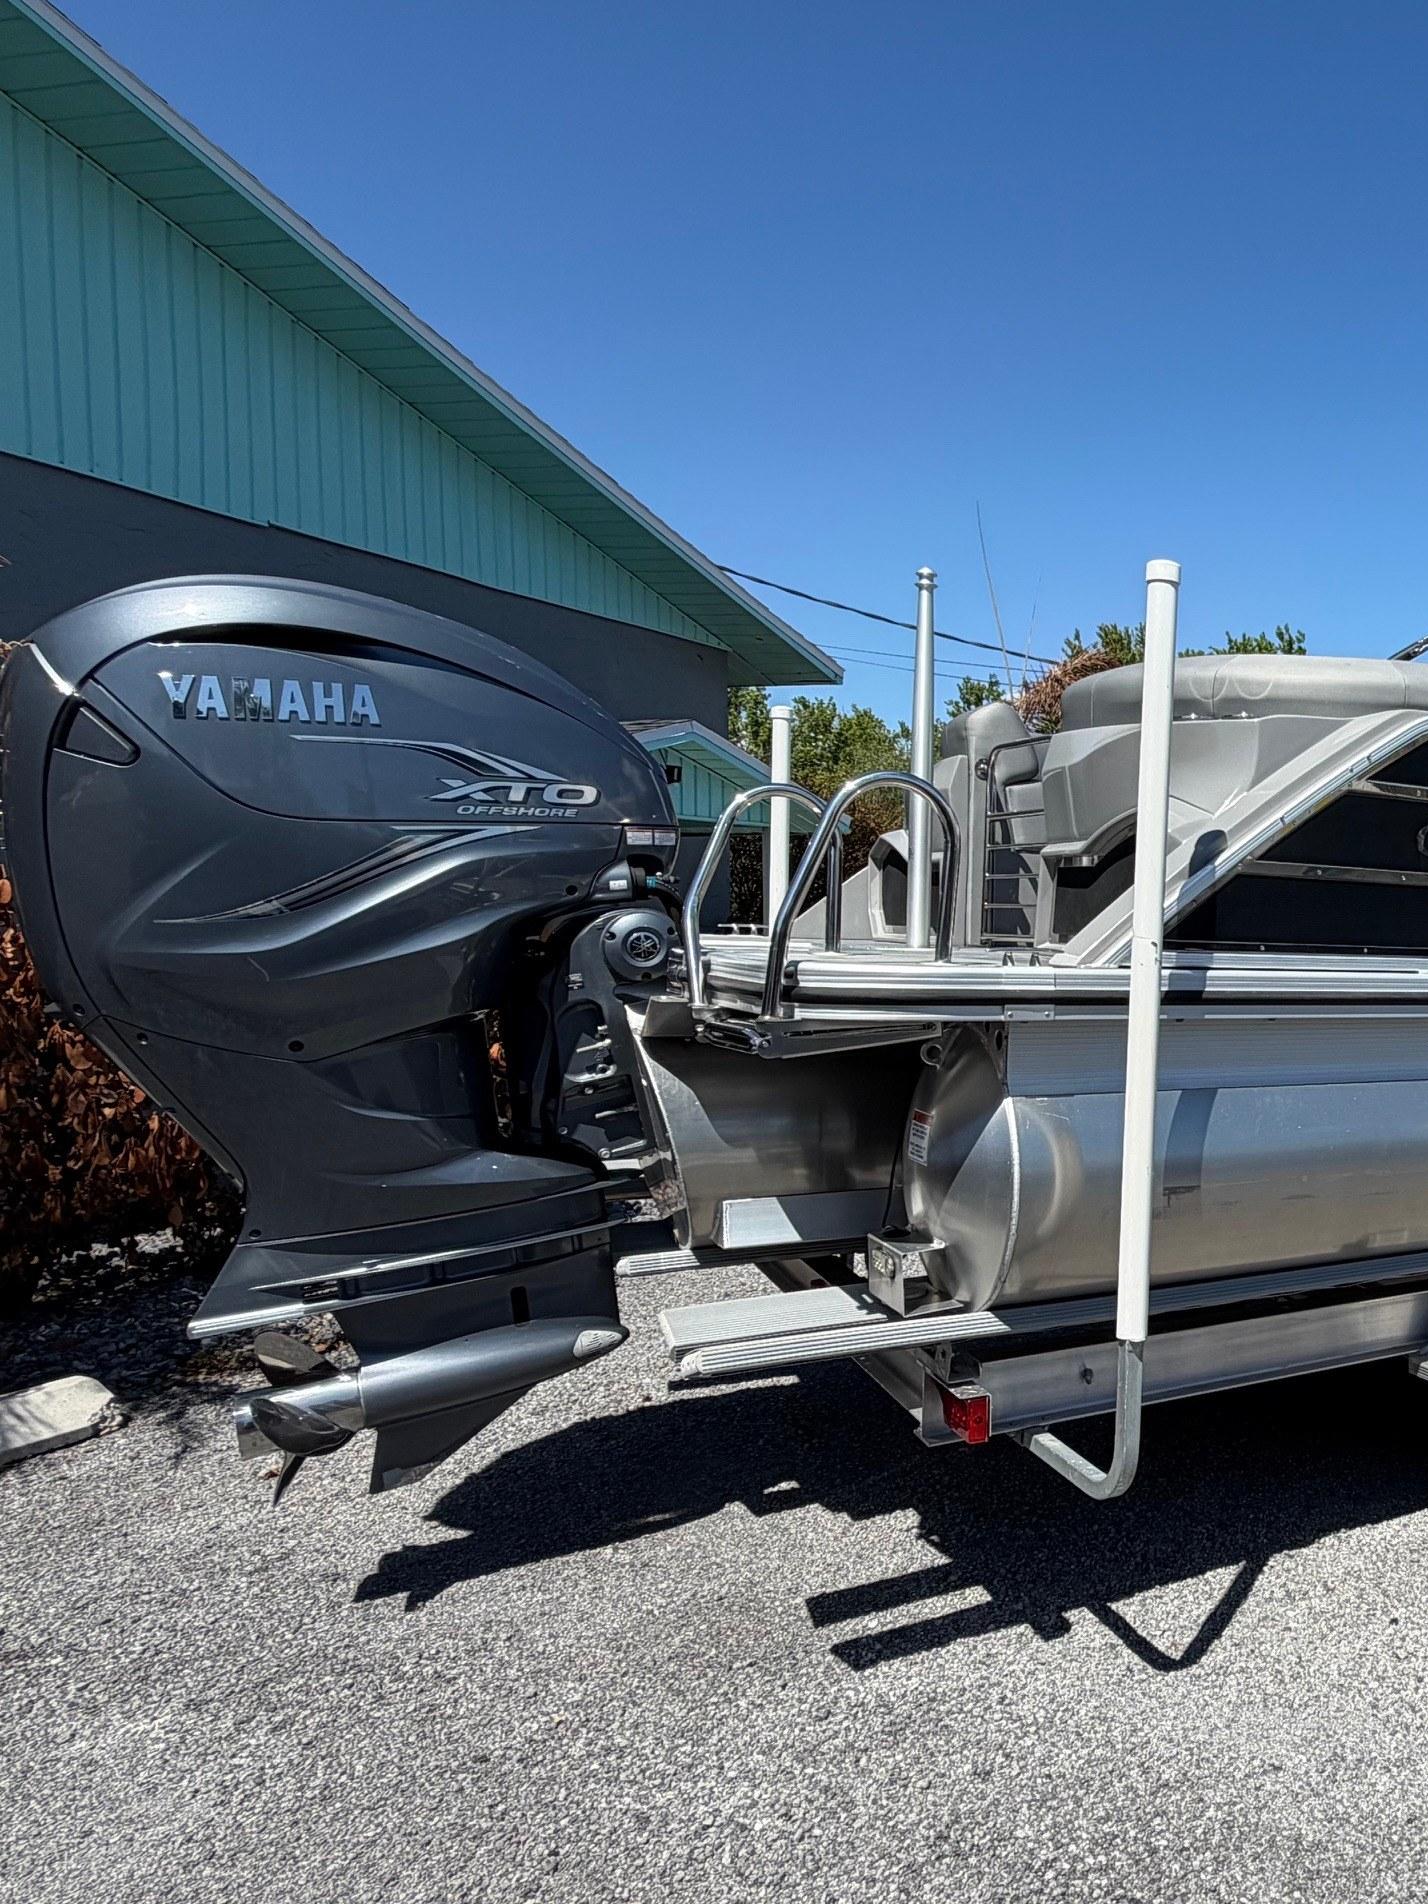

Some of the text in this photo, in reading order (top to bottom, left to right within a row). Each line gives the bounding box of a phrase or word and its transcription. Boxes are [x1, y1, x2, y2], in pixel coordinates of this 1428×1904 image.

[157, 671, 382, 727] YAMAHA
[426, 778, 600, 806] XTO
[456, 805, 578, 818] OFFSHORE
